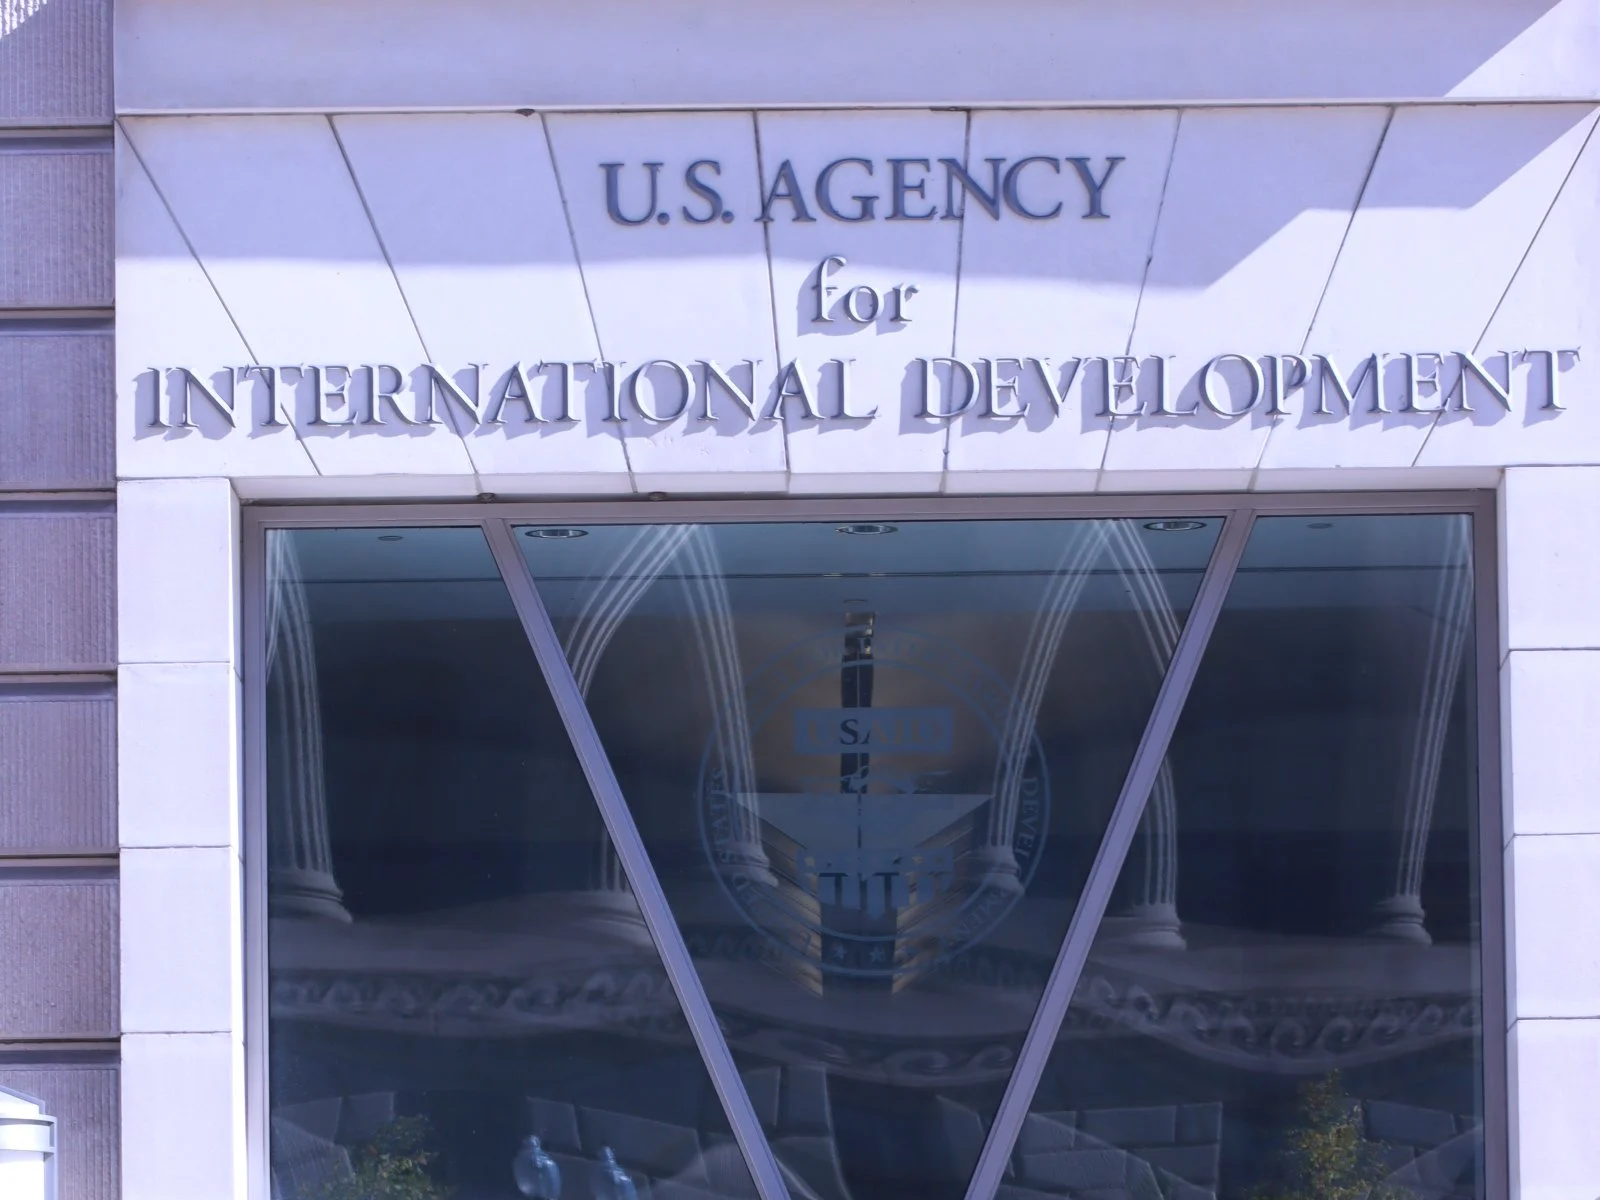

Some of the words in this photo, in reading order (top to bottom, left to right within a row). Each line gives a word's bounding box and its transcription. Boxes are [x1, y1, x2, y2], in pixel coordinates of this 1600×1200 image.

[600, 158, 734, 226] U.S.
[759, 156, 1125, 223] AGENCY
[811, 255, 919, 324] for
[147, 356, 879, 428] INTERNATIONAL
[912, 345, 1581, 419] DEVELOPMENT
